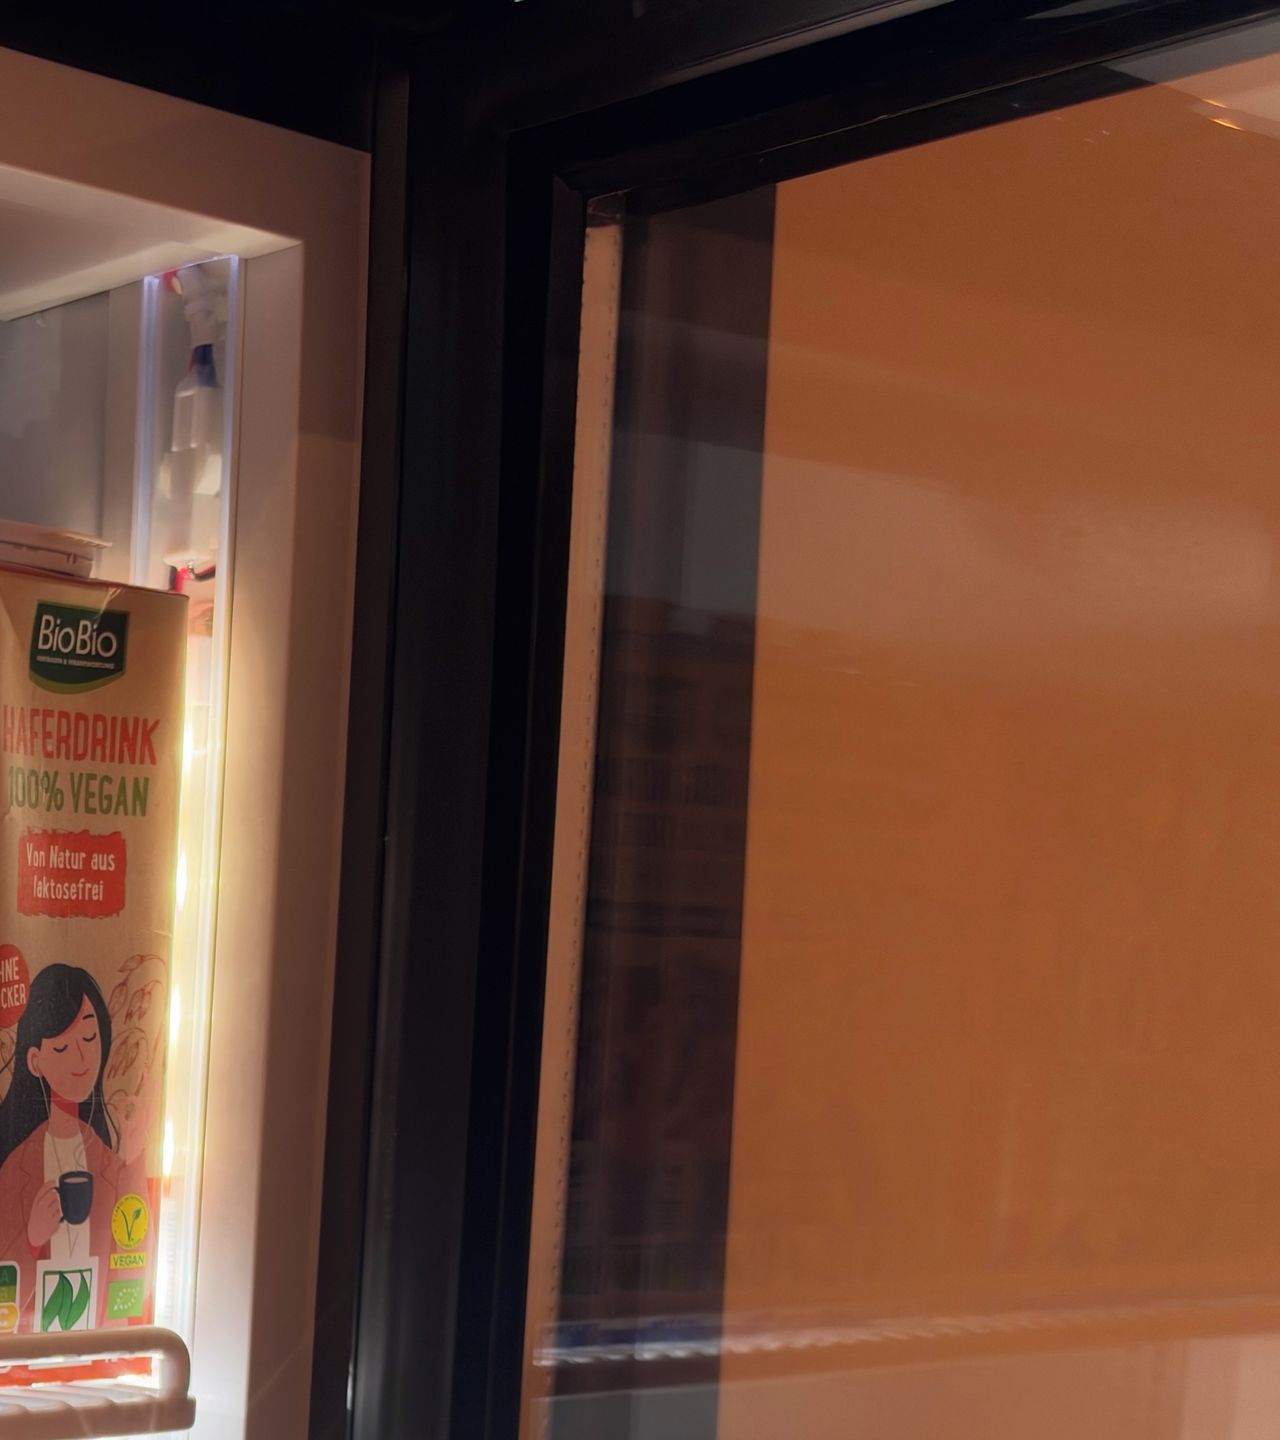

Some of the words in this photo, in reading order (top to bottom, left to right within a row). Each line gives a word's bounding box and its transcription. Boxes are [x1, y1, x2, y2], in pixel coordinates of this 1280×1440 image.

[38, 614, 117, 658] BioBio
[3, 704, 160, 766] HAFERDRINK
[8, 767, 65, 813] 100%
[71, 773, 150, 817] VEGAN
[26, 842, 46, 867] Von
[50, 844, 86, 871] Natur
[91, 852, 115, 871] aus
[33, 875, 104, 902] laktosefrei
[112, 1254, 145, 1267] VEGAN
